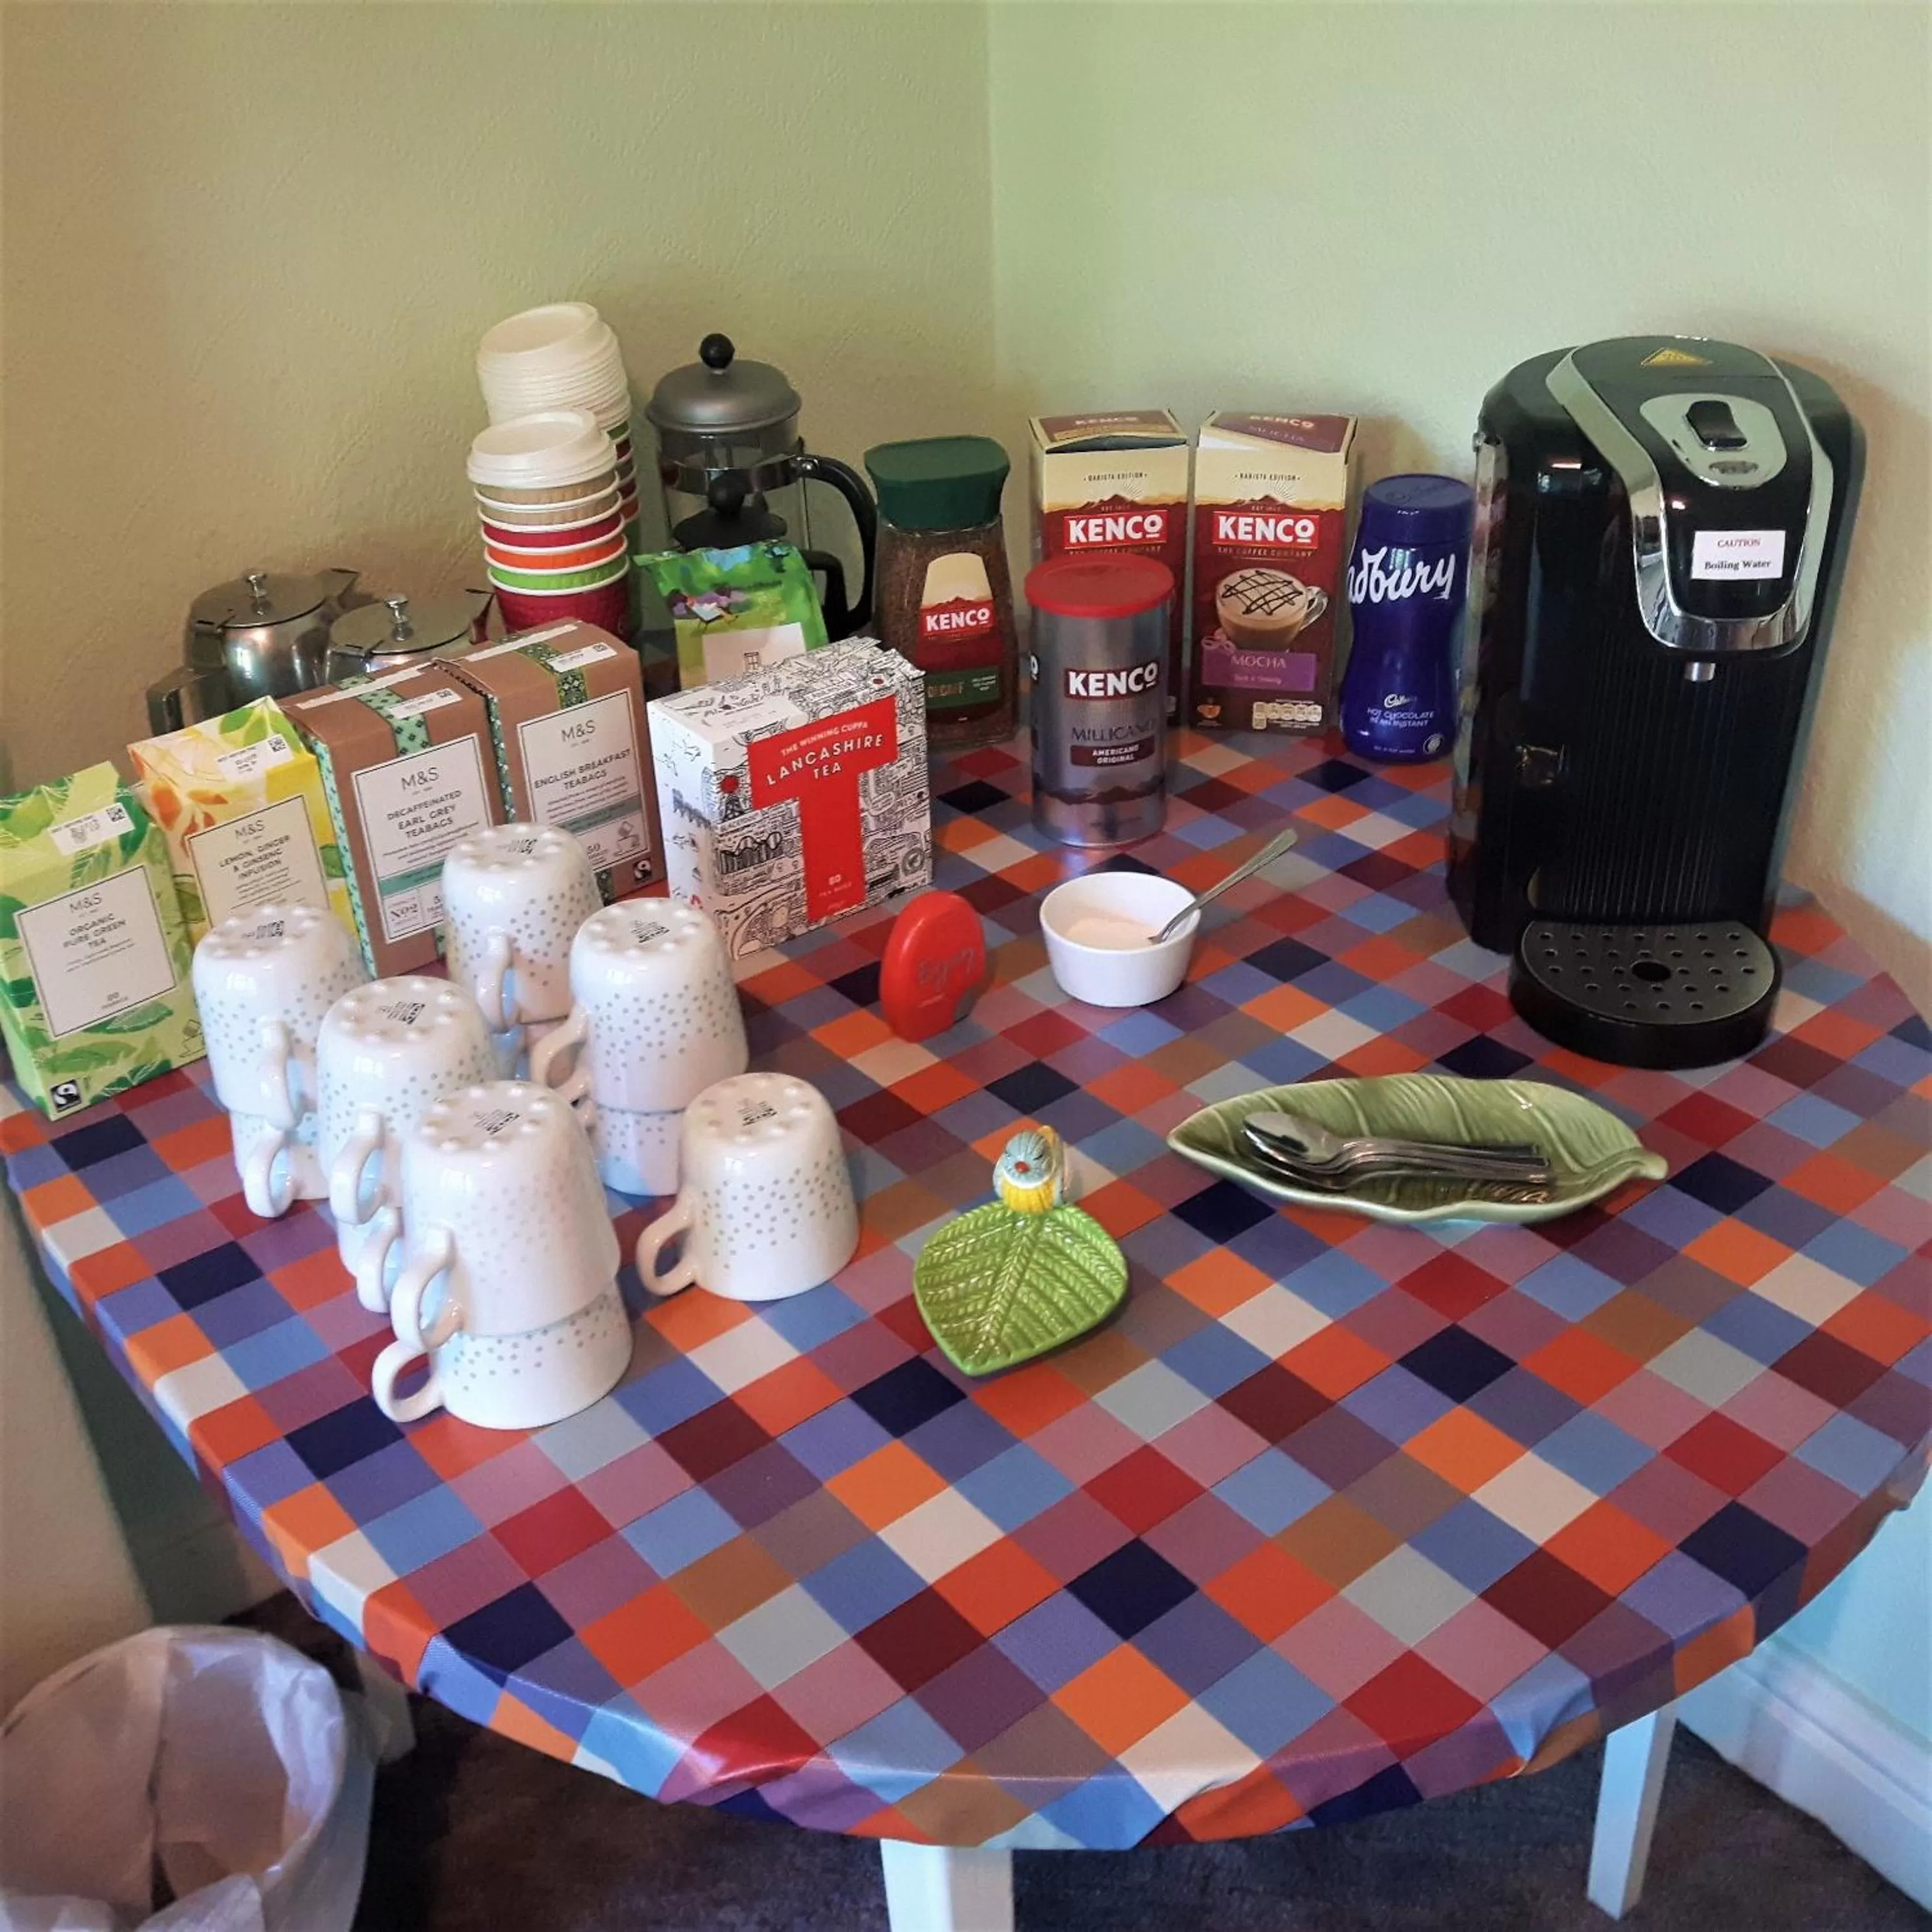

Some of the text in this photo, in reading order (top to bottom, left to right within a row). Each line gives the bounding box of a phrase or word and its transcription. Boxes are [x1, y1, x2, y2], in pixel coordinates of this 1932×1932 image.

[1069, 514, 1163, 543] KENCO
[1218, 515, 1315, 543] KENCO
[1717, 538, 1761, 547] CAUTION
[1348, 546, 1456, 604] adbury
[1704, 560, 1772, 571] Boiling Water
[926, 608, 991, 632] KENCO
[1230, 654, 1287, 669] MOCHA
[1068, 662, 1159, 697] KENCO
[1383, 710, 1435, 721] CHOCOLATE
[560, 719, 596, 742] M&S
[781, 721, 869, 758] THE WINNING CUPPA
[767, 734, 884, 786] LANCASHIRE
[1092, 744, 1140, 757] AMERICANO
[1096, 754, 1135, 765] ORIGINAL
[401, 767, 440, 790] M&S
[534, 748, 631, 789] ENGLISH BREAKFAST
[564, 769, 608, 790] TEABAGS
[813, 762, 842, 780] TEA
[386, 789, 463, 821] DECAFFEINATED
[397, 804, 456, 830] EARL GREY
[404, 816, 454, 838] TEABAGS
[234, 820, 266, 839] M&S
[69, 891, 103, 913] M&S
[69, 913, 116, 935] ORGANIC
